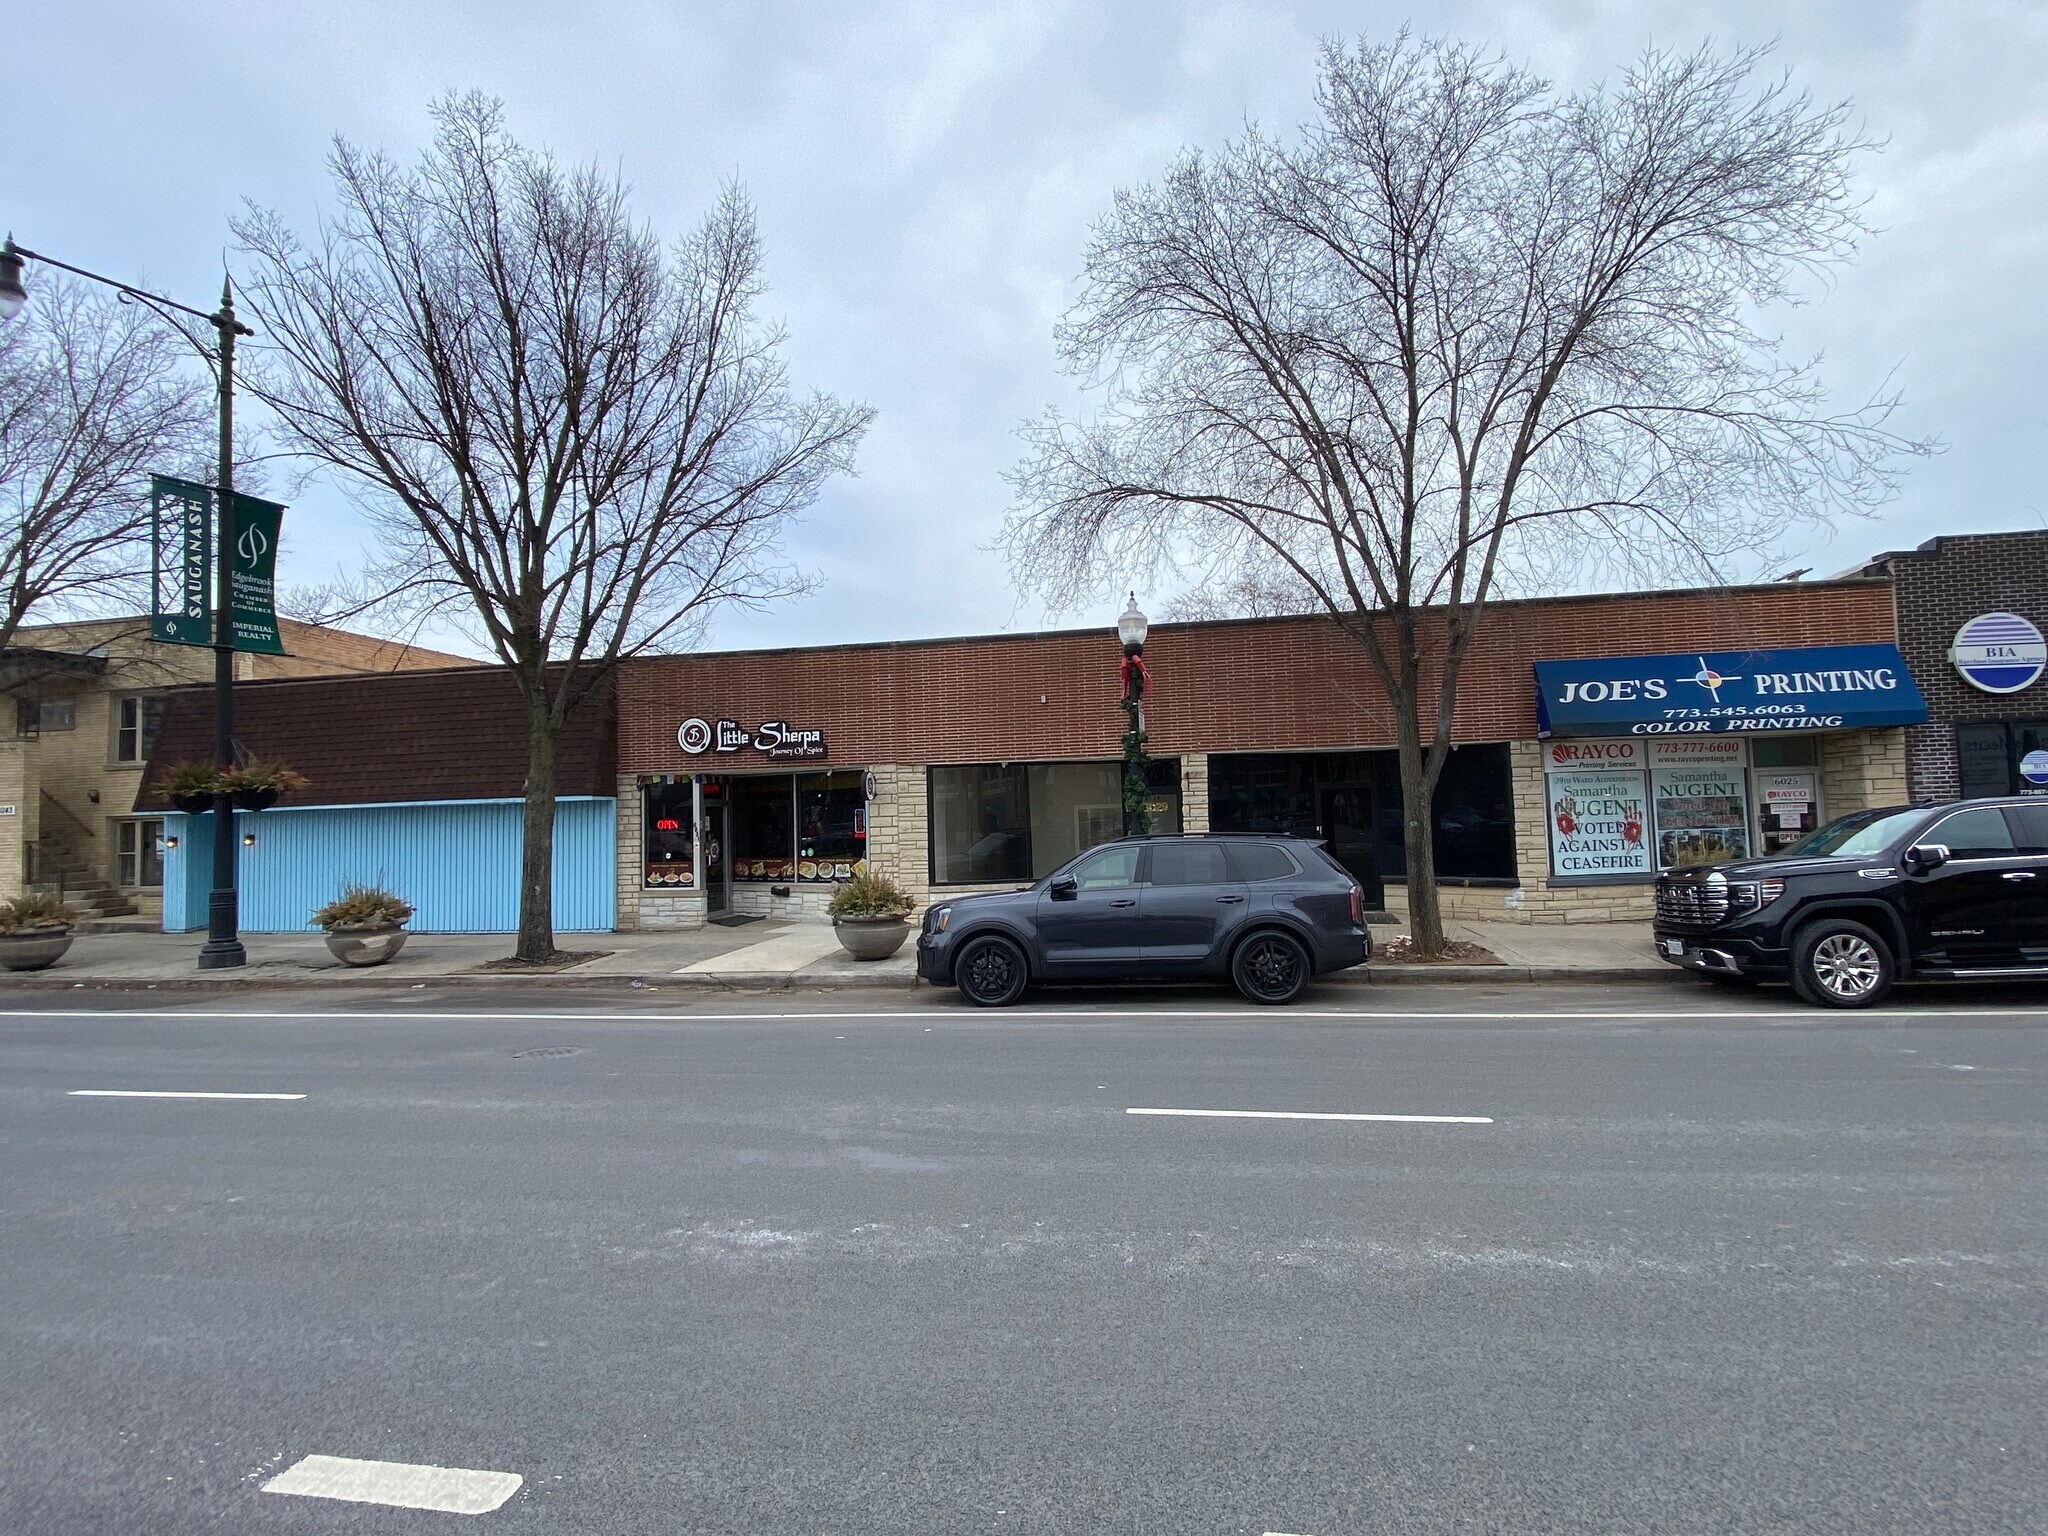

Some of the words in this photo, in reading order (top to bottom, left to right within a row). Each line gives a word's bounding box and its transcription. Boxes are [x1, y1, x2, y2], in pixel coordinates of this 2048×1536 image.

[188, 499, 203, 619] SAUGANASH
[231, 570, 273, 587] Edgebrook
[232, 622, 275, 633] IMPERIAL
[237, 631, 273, 641] REALTY
[1986, 647, 2017, 657] BIA
[1558, 678, 1668, 704] JOE'S
[1753, 668, 1897, 695] PRINTING
[1662, 704, 1806, 718] 773.545.6063
[1631, 721, 1712, 734] COLOR
[1726, 716, 1844, 731] PRINTING
[716, 720, 749, 752] Little
[754, 722, 820, 751] Sherpa
[806, 746, 824, 755] Spice
[1567, 743, 1634, 760] RAYCO
[1656, 742, 1739, 754] 773-777-6600
[1578, 761, 1606, 769] Printing
[1607, 760, 1637, 768] Services
[1657, 755, 1738, 764] www.raycoprinting.net
[1670, 770, 1728, 783] Samantha
[1774, 777, 1799, 785] 6025
[1563, 784, 1628, 797] Samantha
[1659, 783, 1739, 797] NUGENT
[1554, 799, 1642, 817] NUGENT
[657, 819, 679, 830] OPEN
[1573, 821, 1628, 835] VOTED
[1779, 833, 1800, 841] OPEN
[1557, 838, 1628, 853] AGAINST
[1633, 838, 1645, 850] A
[1561, 855, 1643, 870] CEASEFIRE
